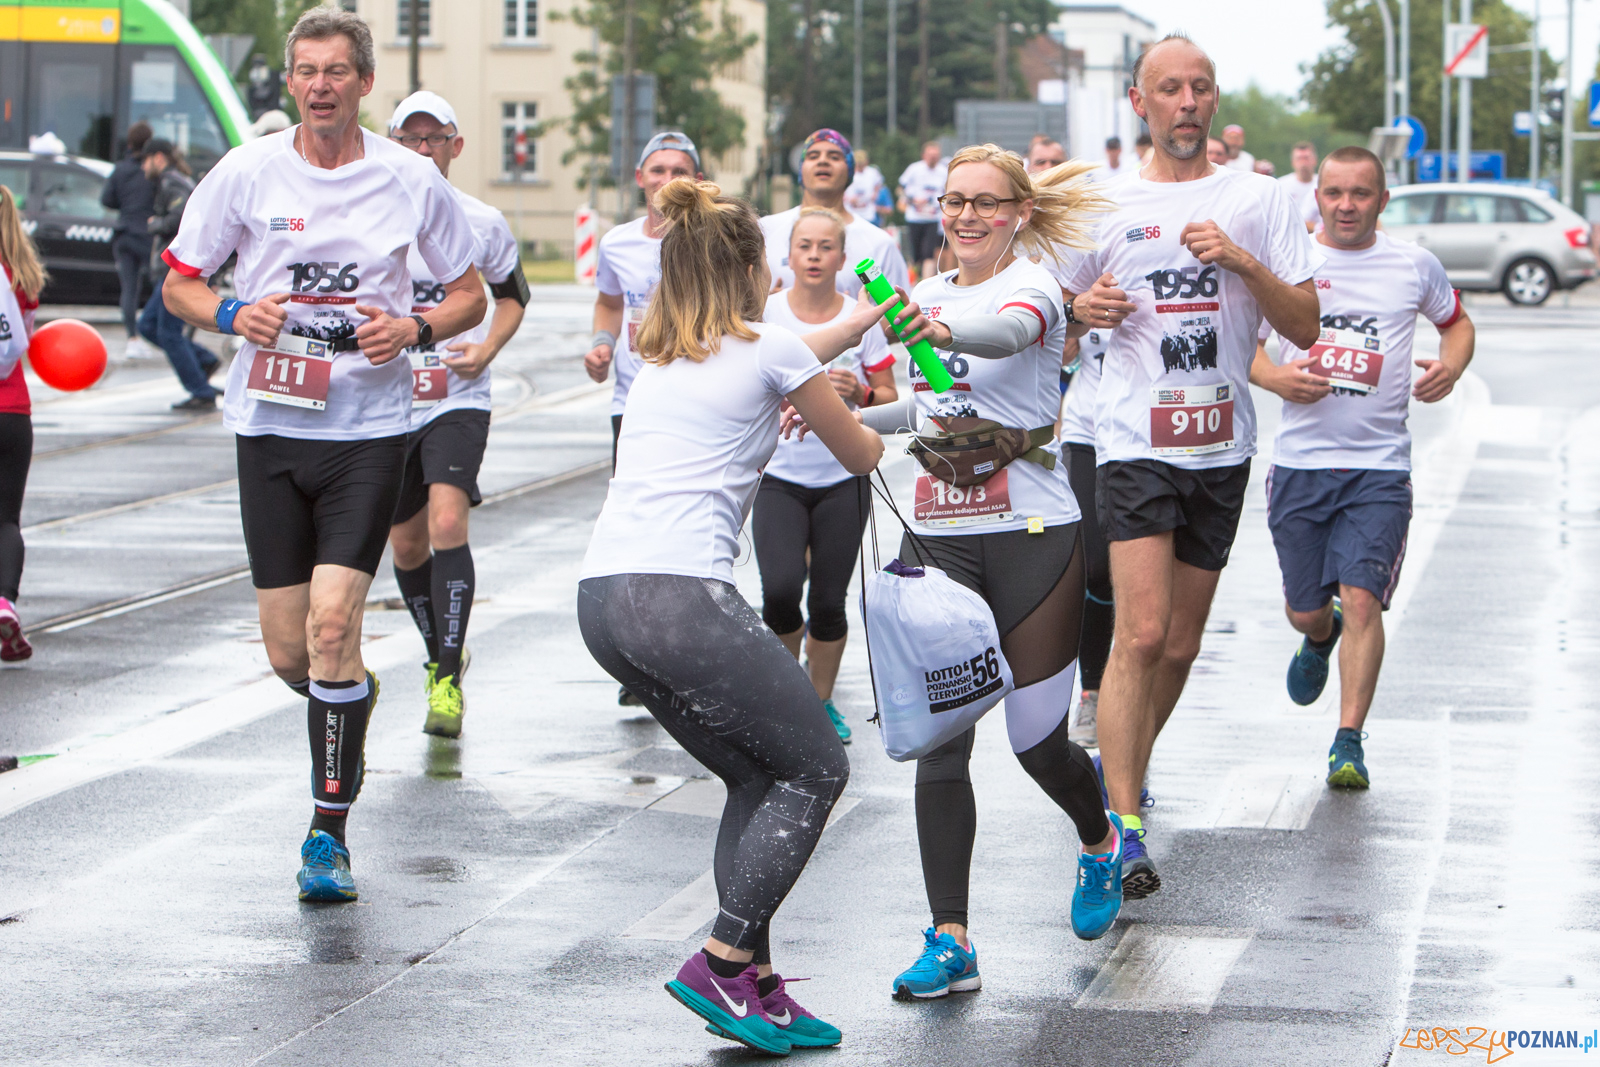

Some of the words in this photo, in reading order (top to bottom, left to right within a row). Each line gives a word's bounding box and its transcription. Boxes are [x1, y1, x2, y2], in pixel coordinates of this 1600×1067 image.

[286, 261, 360, 293] 1956
[1145, 265, 1218, 300] 1956
[265, 355, 307, 386] 111
[1320, 348, 1370, 374] 645
[1171, 408, 1221, 436] 910
[991, 503, 1007, 511] ASAP
[444, 580, 469, 648] Kalenji
[925, 664, 963, 683] LOTTO
[926, 674, 972, 692] POZNAŃSKI
[928, 682, 973, 702] CZERWIEC
